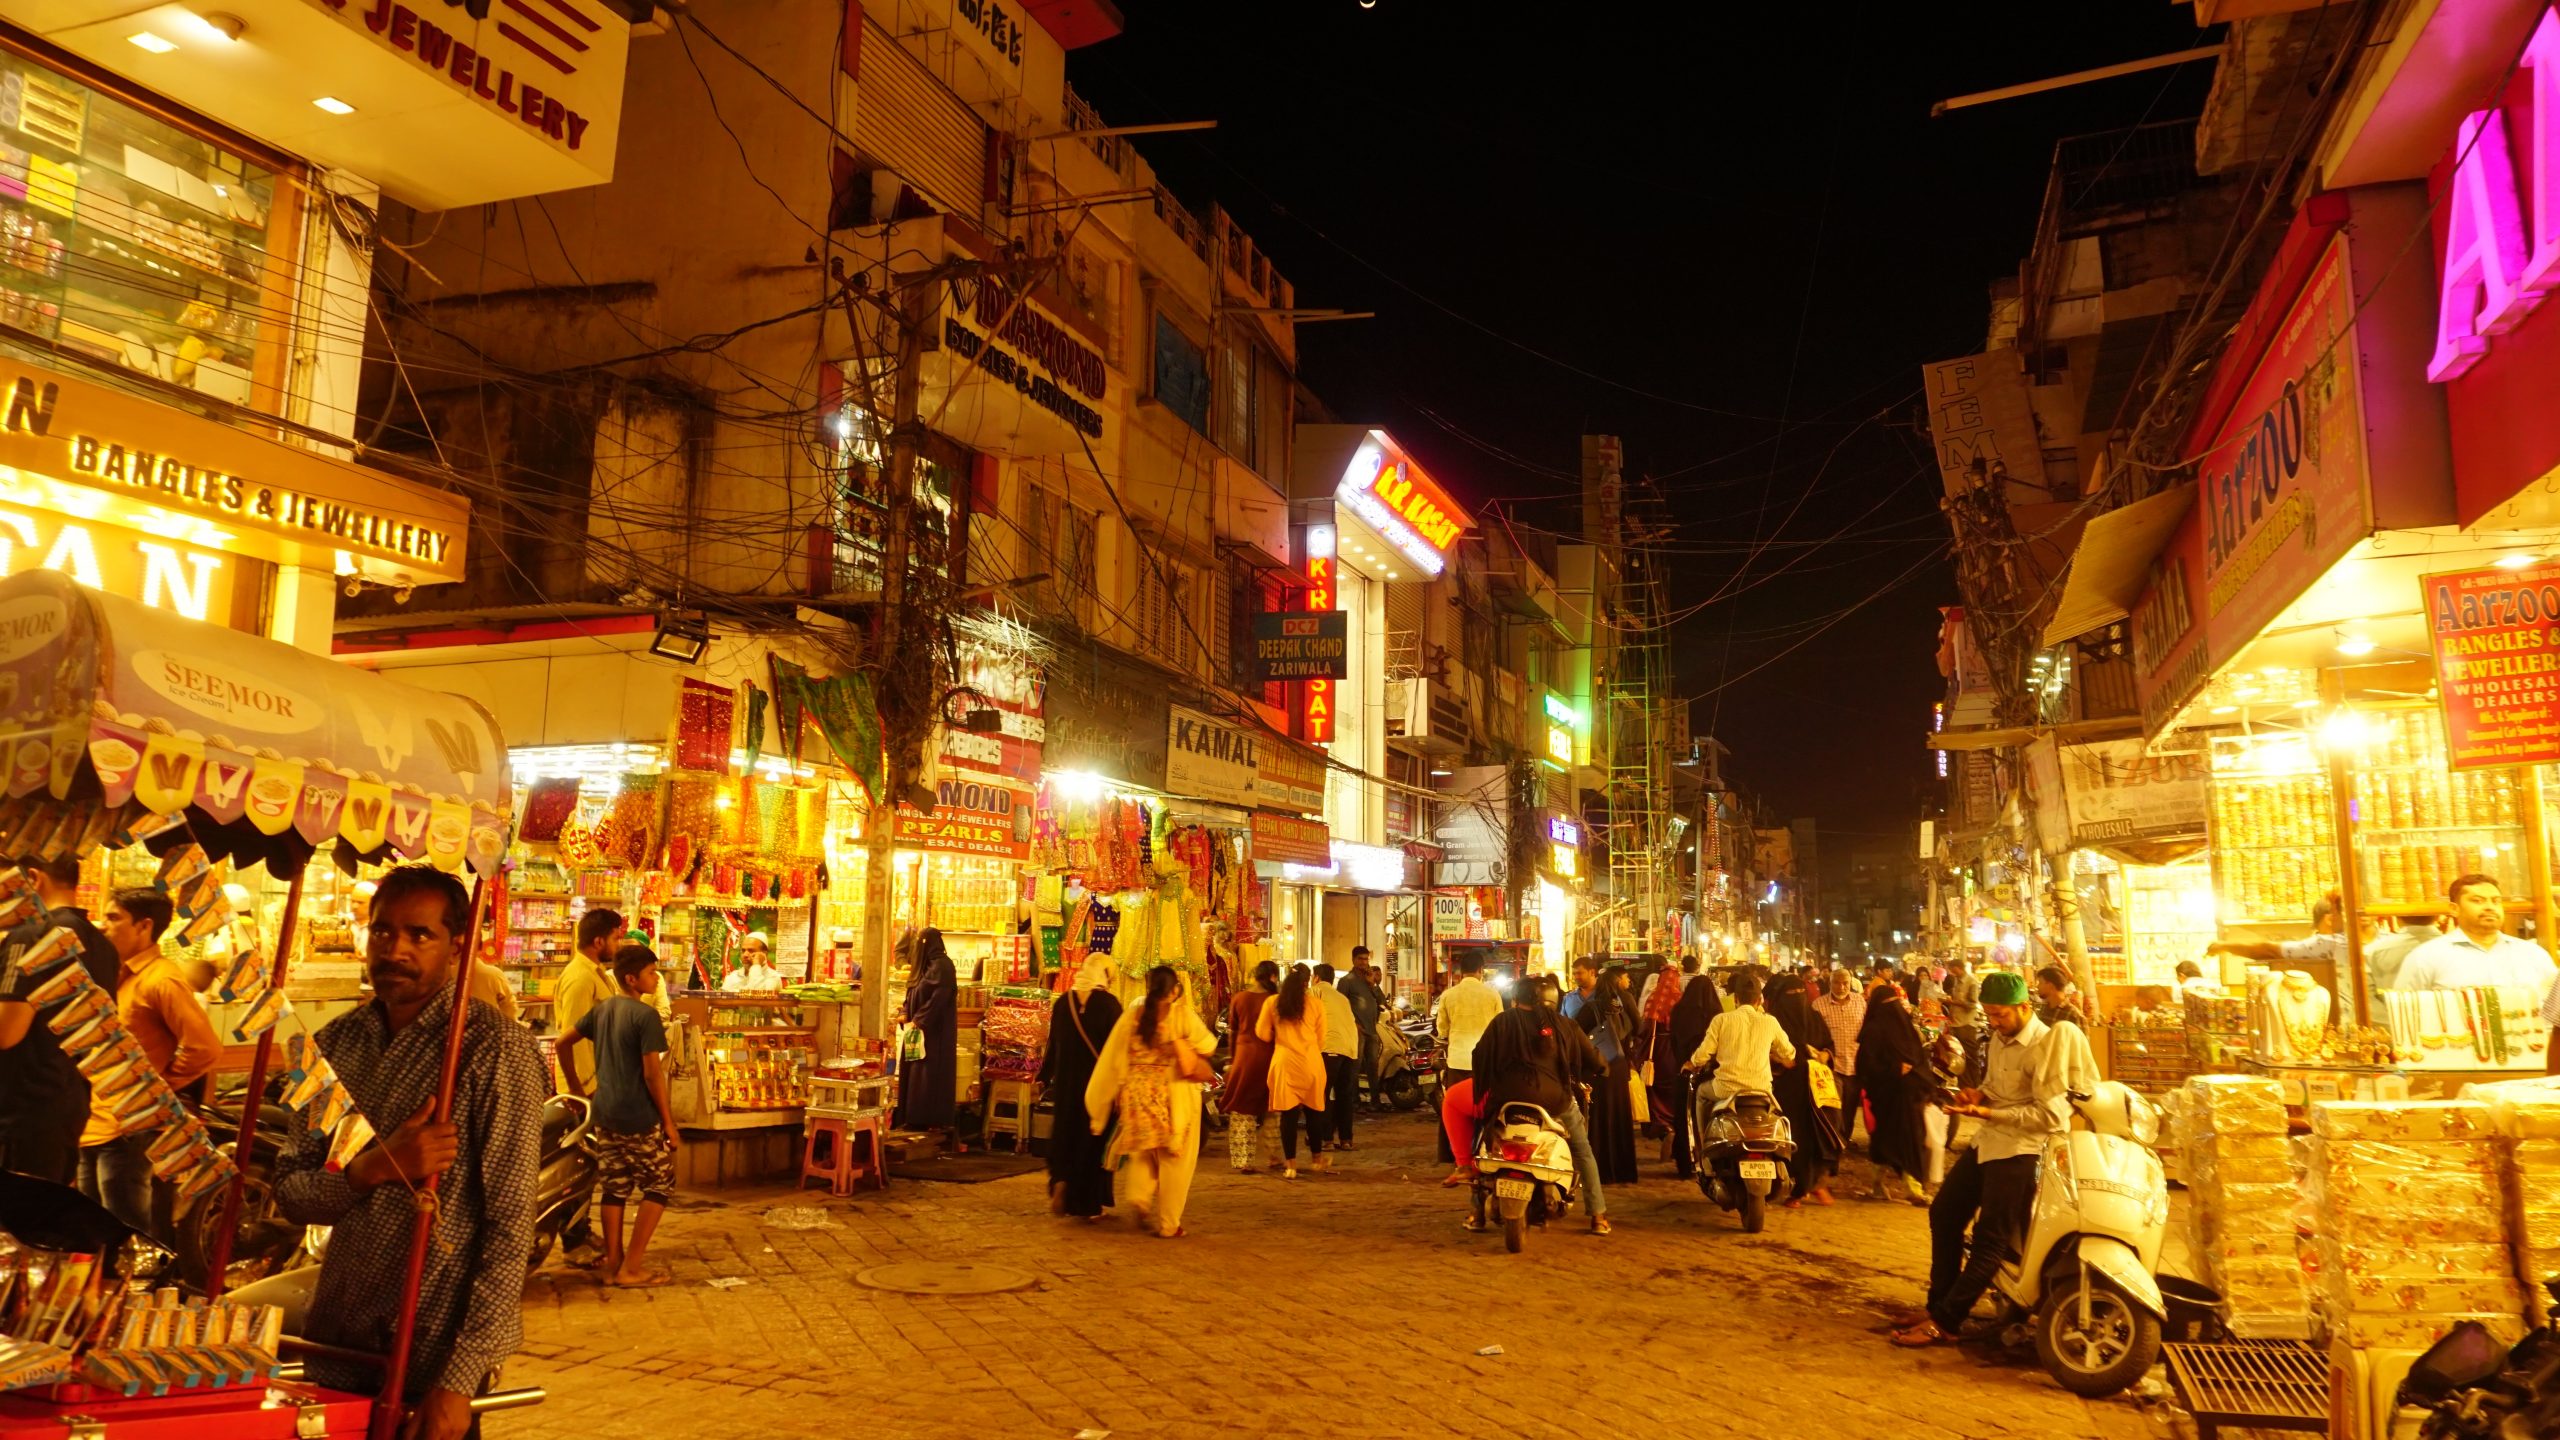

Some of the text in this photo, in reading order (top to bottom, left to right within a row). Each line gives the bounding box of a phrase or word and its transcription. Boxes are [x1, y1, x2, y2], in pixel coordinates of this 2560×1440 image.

[364, 0, 589, 150] JEWELLERY
[1937, 360, 2003, 500] FEM
[2205, 377, 2302, 584] Aarzoo
[74, 434, 244, 509] BANGLES
[256, 487, 274, 518] &
[287, 491, 450, 563] JEWELLERY
[1403, 493, 1461, 550] KASAT
[2436, 584, 2560, 633] Aarzoo
[1284, 620, 1318, 635] DCZ
[1258, 637, 1343, 660] DEEPAK CHAND
[2442, 627, 2560, 658] BANGLES &
[1269, 662, 1332, 676] ZARIWALA
[2443, 652, 2560, 683] JEWELLER
[164, 659, 295, 719] SEEMOR
[168, 685, 226, 710] Ice Cream
[2453, 674, 2560, 697] WHOLESAL
[2473, 689, 2558, 709] DEALERS
[1175, 716, 1257, 768] KAMAL
[933, 778, 1013, 817] MOND
[894, 808, 1012, 830] ANGLES & JEWELLERS
[902, 820, 1004, 843] PEARLS
[2079, 820, 2132, 840] WHOLESALE
[967, 842, 1013, 855] DEALER
[1446, 841, 1465, 849] Gram
[1434, 899, 1464, 915] 100%
